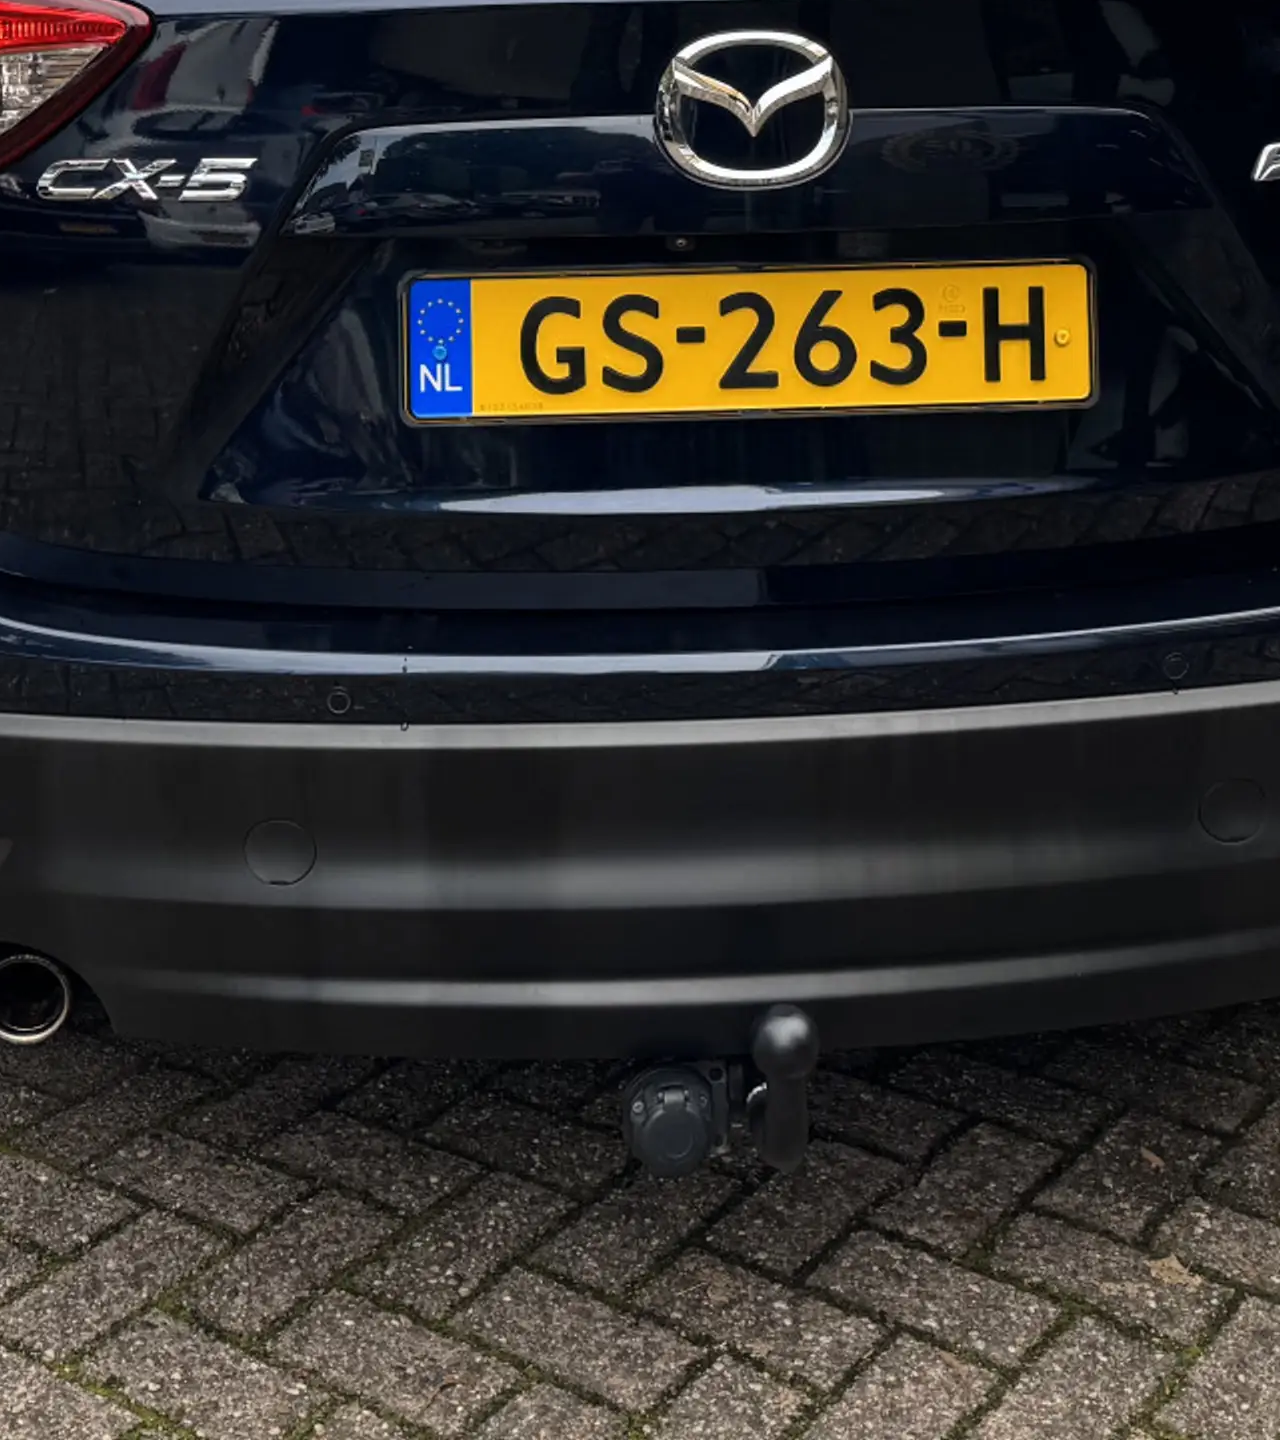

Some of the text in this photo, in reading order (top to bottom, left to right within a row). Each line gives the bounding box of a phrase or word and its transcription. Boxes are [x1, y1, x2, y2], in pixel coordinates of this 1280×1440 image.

[36, 157, 259, 202] CX-5
[419, 286, 1047, 396] NL GS-263-H
